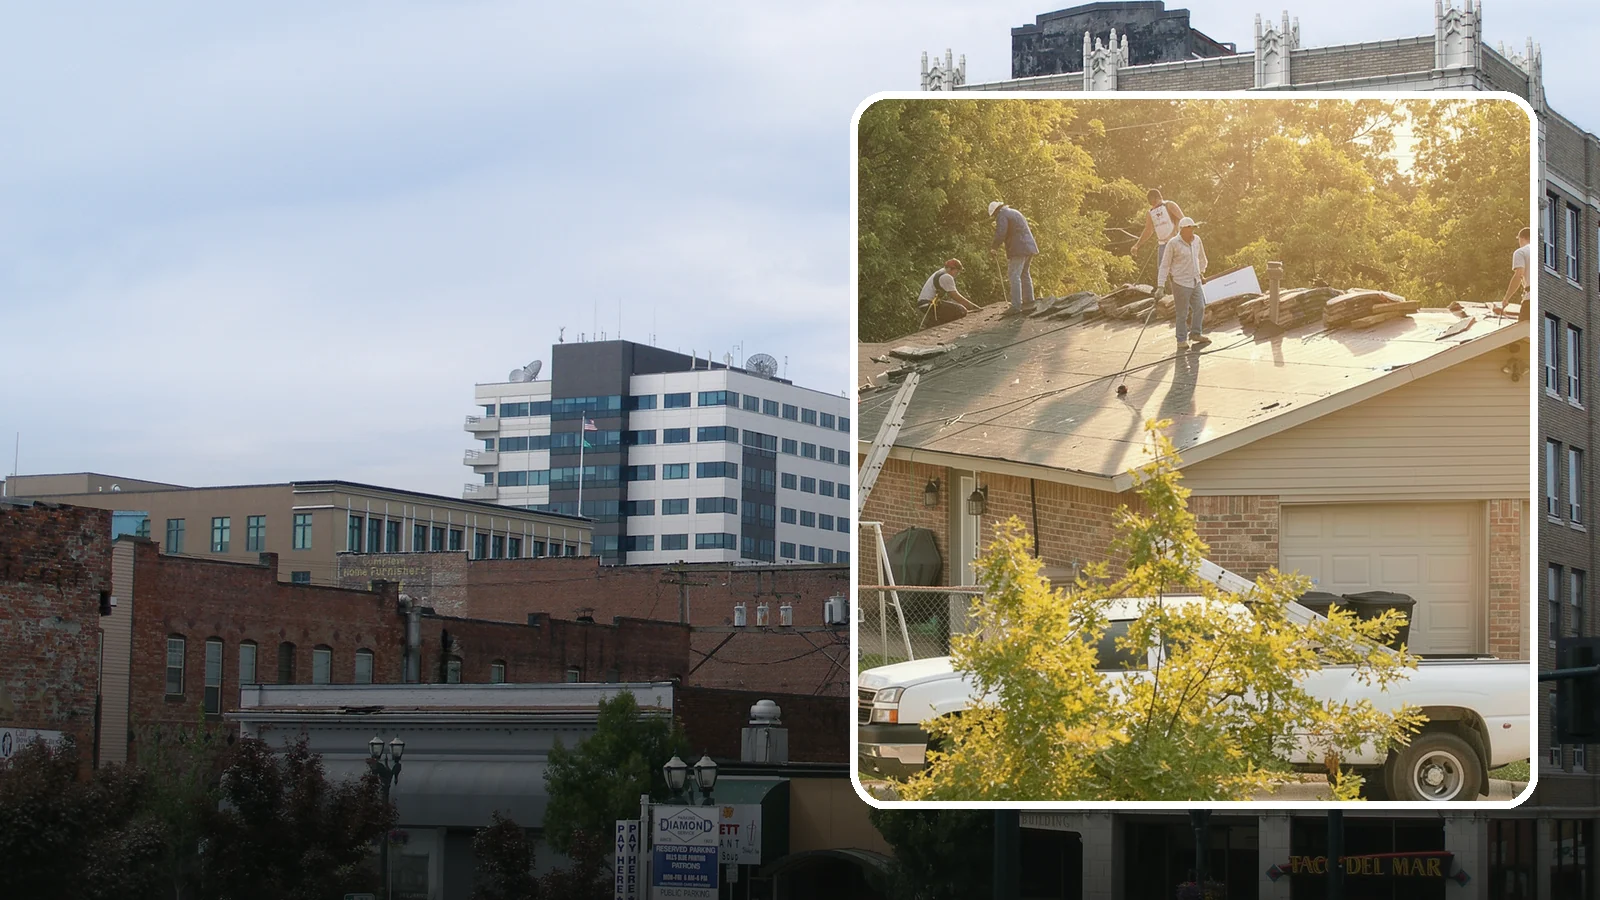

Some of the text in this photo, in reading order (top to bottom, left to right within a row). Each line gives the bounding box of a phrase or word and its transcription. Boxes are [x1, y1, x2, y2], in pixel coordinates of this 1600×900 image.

[343, 566, 427, 577] Home Furnishers
[660, 818, 713, 833] DIAMOND
[1022, 815, 1069, 828] BUILDING
[617, 825, 625, 852] PAY
[628, 824, 636, 852] PAY
[656, 845, 716, 854] RESERVED PARKING
[721, 851, 739, 862] Soup
[671, 862, 701, 870] PATRONS
[1289, 855, 1441, 877] TAC DEL MAR
[616, 856, 625, 894] HERE
[627, 856, 636, 893] HERE
[660, 888, 710, 898] PUBLIC PARKING
